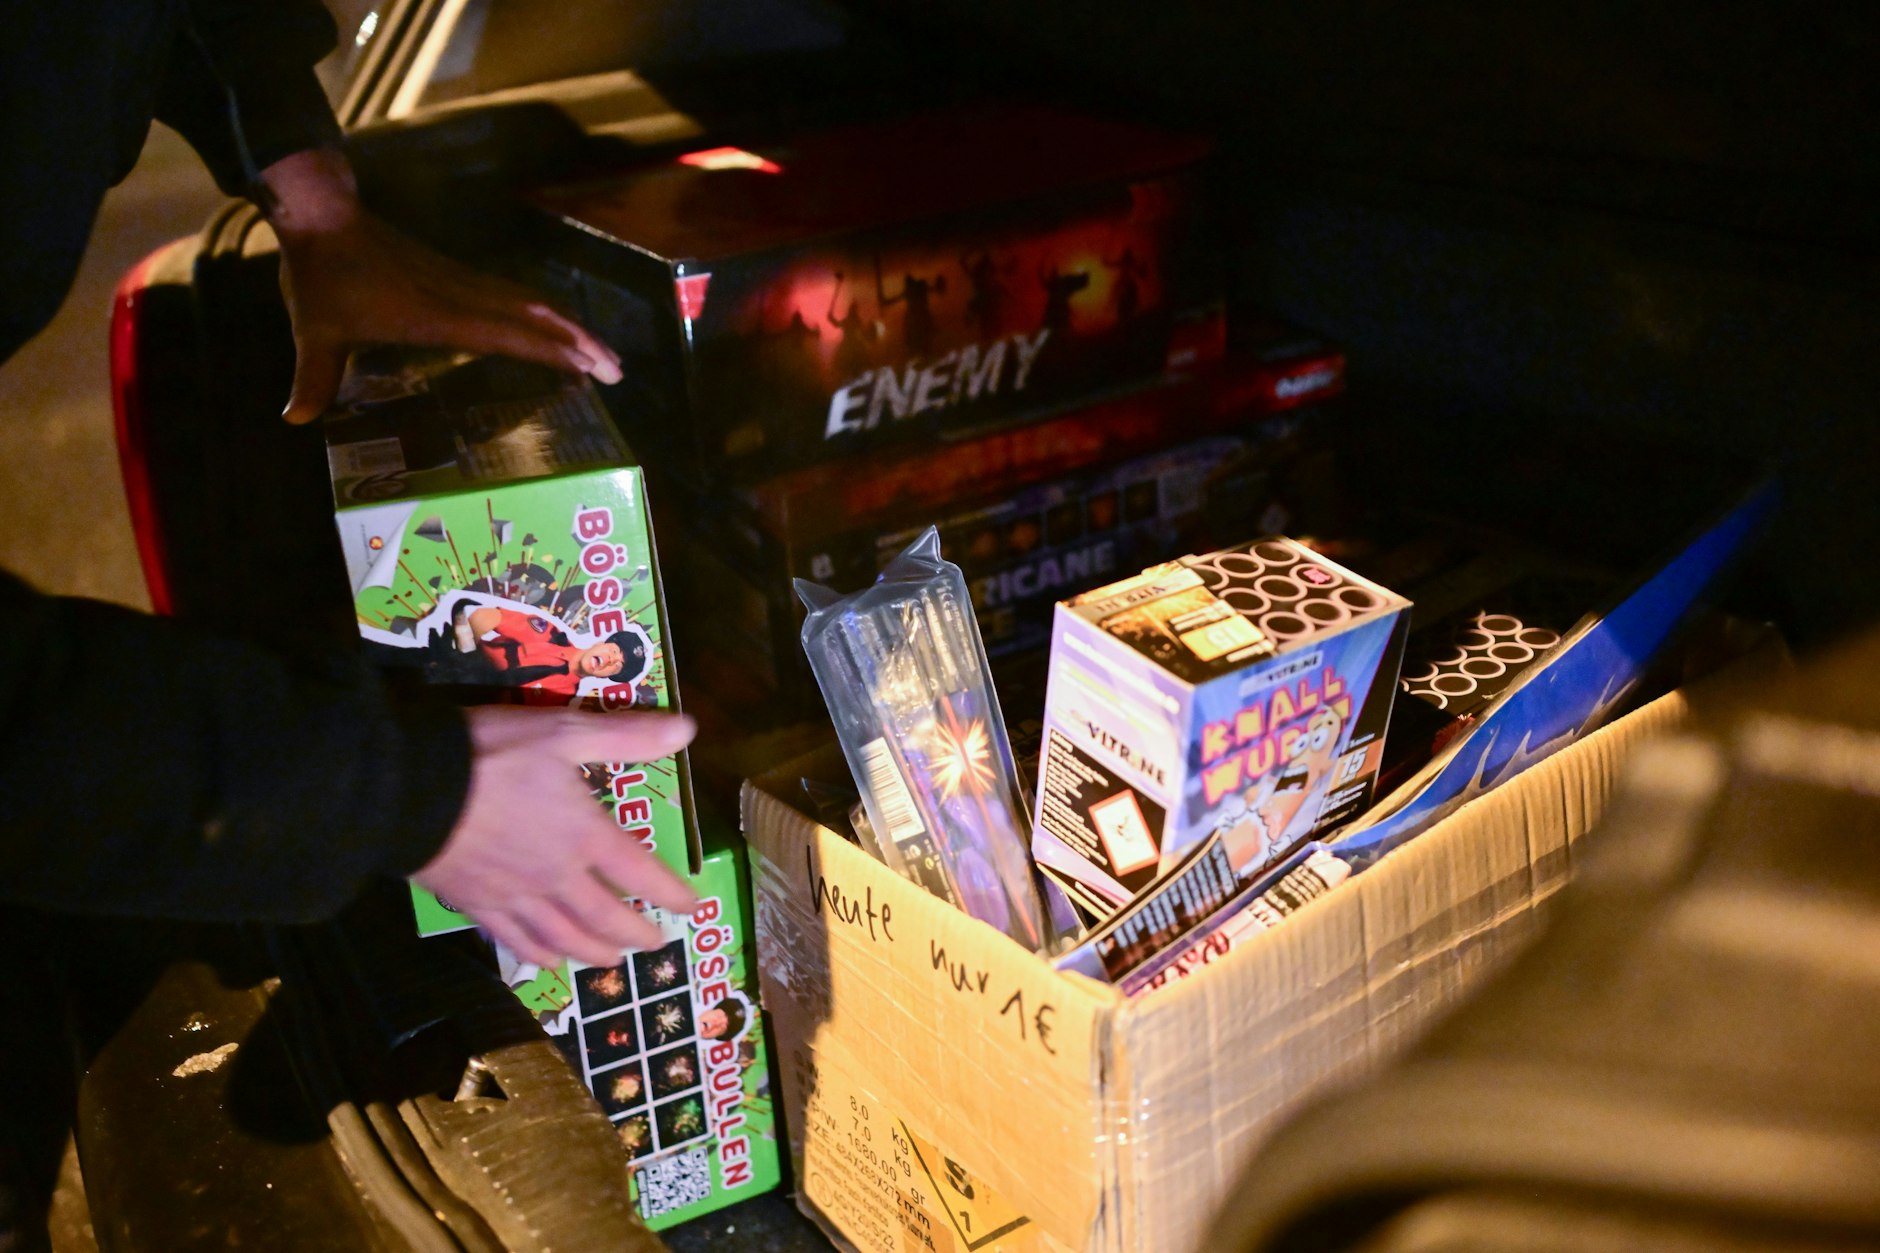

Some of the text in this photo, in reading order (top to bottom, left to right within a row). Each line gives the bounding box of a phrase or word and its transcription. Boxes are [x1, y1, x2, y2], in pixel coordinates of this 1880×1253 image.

[825, 328, 1052, 439] ENEMY
[577, 508, 628, 638] BÖSE
[1201, 665, 1346, 766] KNALL
[1341, 746, 1369, 781] 15
[806, 844, 894, 942] heute
[931, 939, 990, 995] nur
[691, 896, 753, 1190] BÖSE BULLEN
[847, 1132, 897, 1182] 1680.00
[911, 1187, 926, 1206] gr
[850, 1095, 869, 1121] 8.0
[891, 1127, 909, 1155] kg
[852, 1116, 872, 1142] 7.0
[894, 1149, 912, 1177] kg
